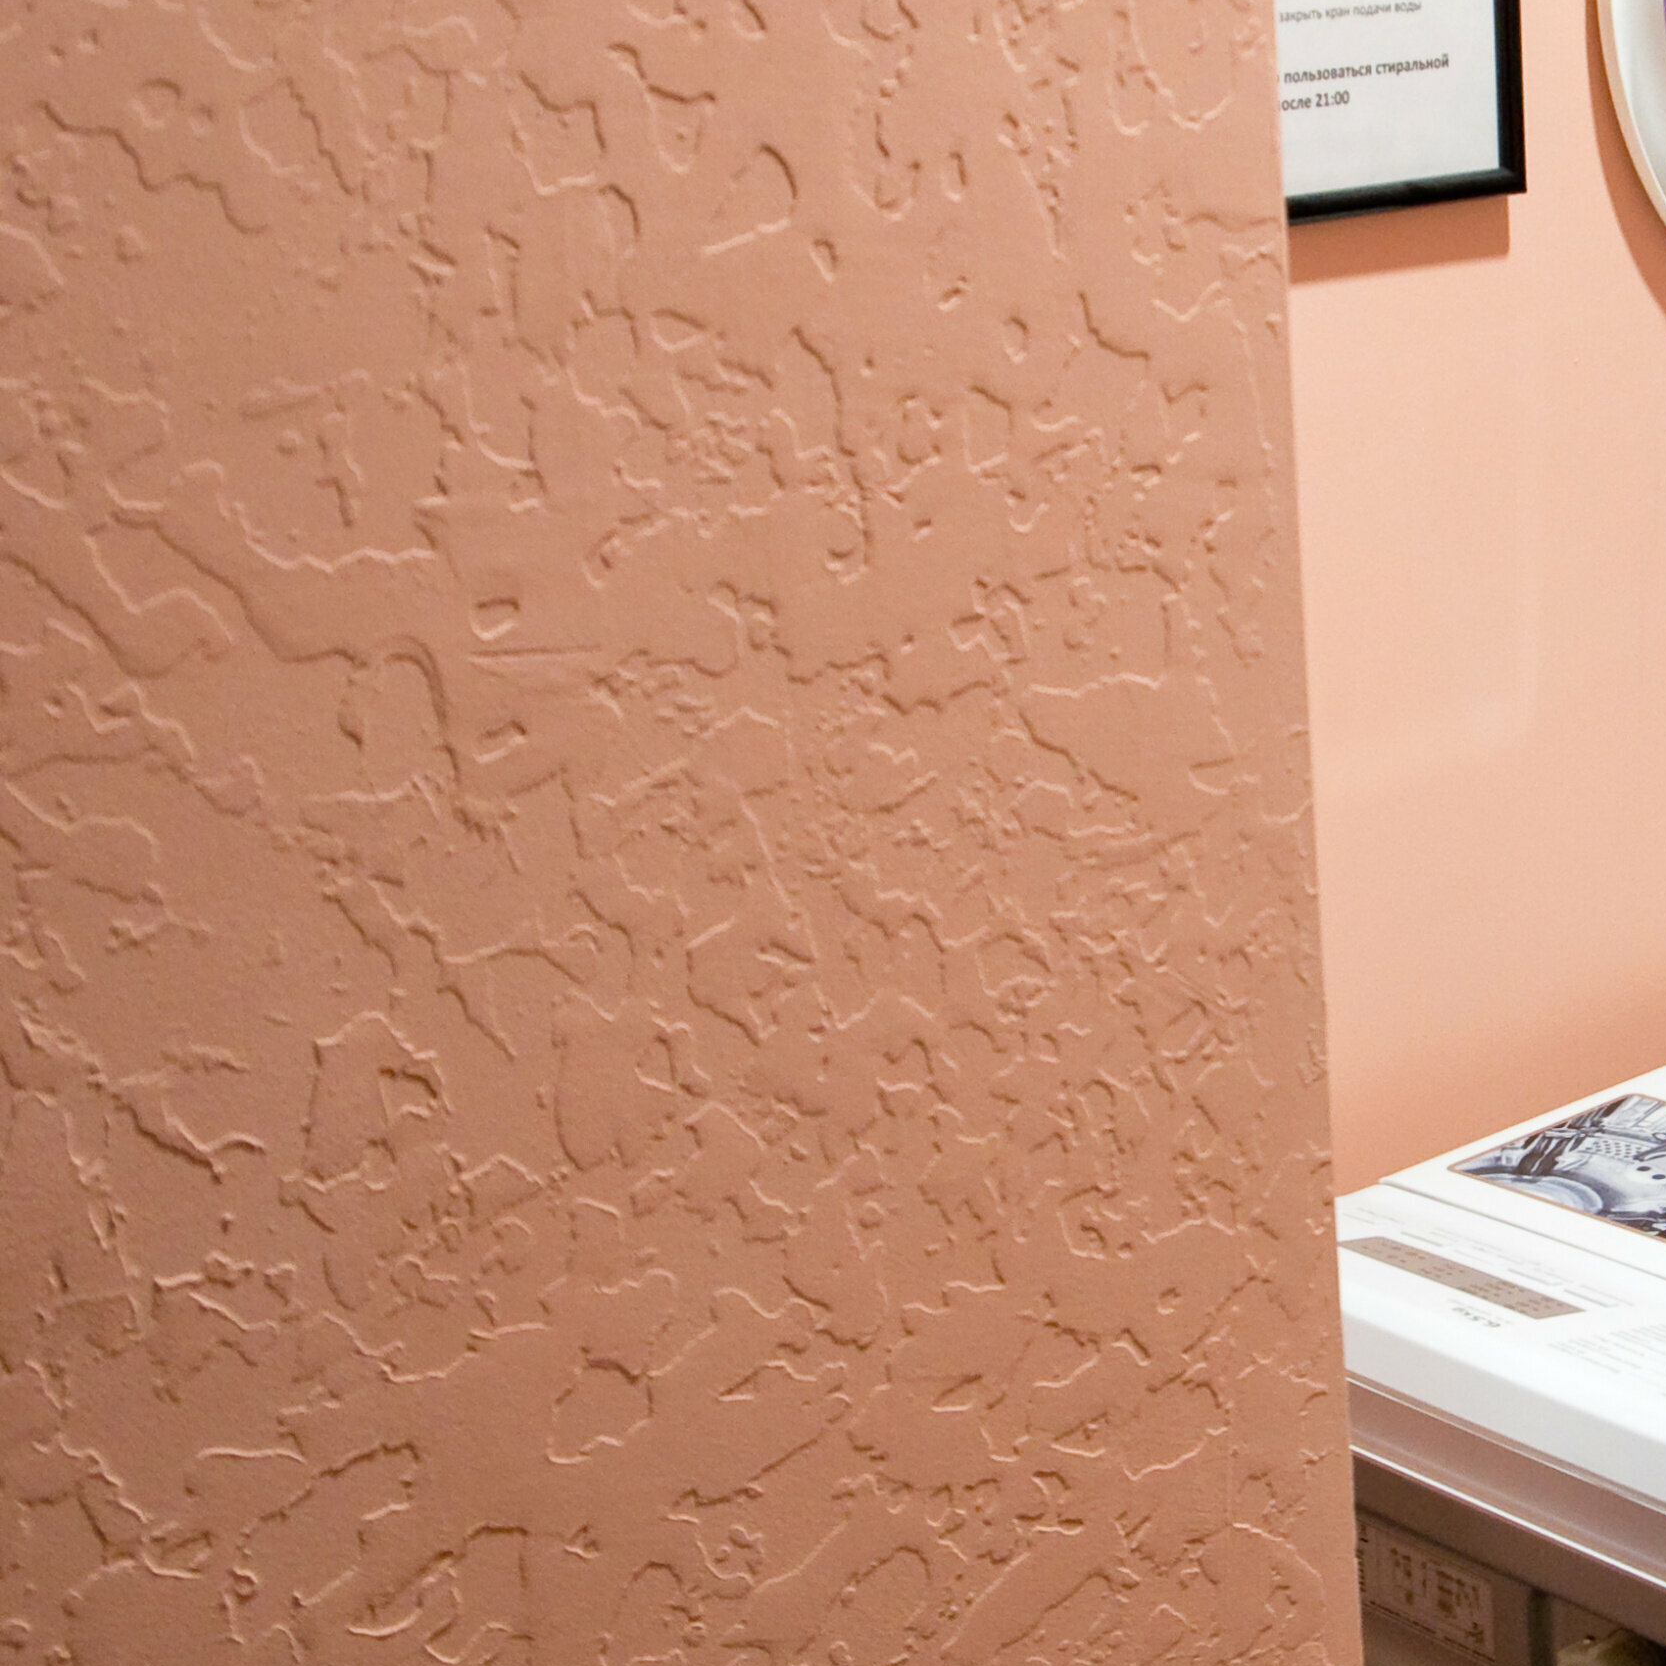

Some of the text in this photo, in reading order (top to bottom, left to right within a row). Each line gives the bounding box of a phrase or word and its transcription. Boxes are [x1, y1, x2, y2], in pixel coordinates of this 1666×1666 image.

[1279, 1, 1422, 23] закрыть кран подачи воды
[1284, 64, 1372, 84] пользоваться
[1375, 53, 1449, 75] стиральной
[1315, 89, 1350, 108] 21:00
